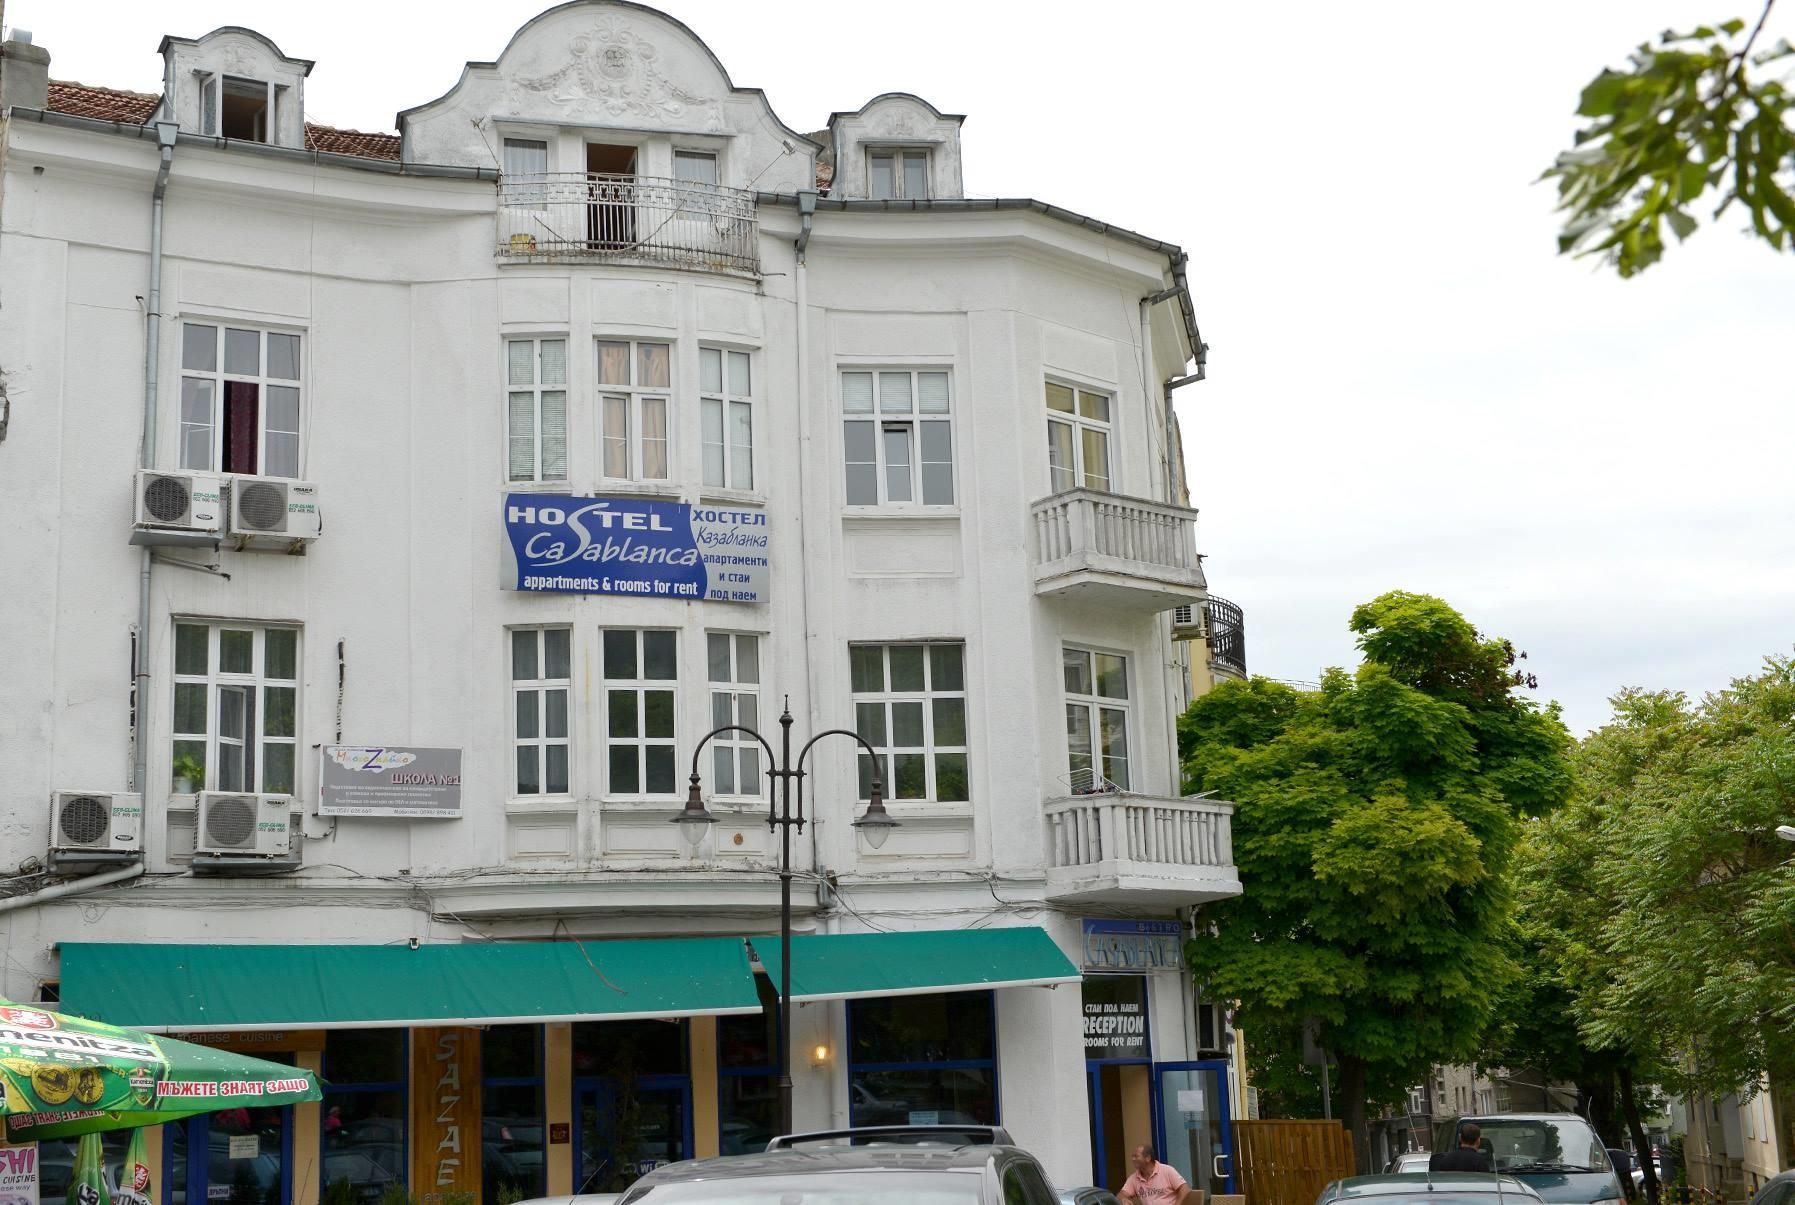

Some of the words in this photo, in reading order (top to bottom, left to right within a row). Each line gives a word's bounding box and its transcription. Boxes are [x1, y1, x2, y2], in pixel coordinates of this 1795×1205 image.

[508, 503, 673, 535] HOSTEL
[692, 509, 766, 526] ХОСТЕЛ
[697, 526, 768, 548] Казабланка
[703, 552, 768, 567] апартаменти
[719, 572, 725, 582] и
[728, 572, 750, 583] стаи
[524, 575, 599, 591] appartments
[603, 577, 611, 591] &
[614, 580, 651, 592] rooms
[654, 579, 670, 593] for
[674, 581, 698, 595] rent
[711, 590, 729, 601] под
[732, 590, 757, 601] наем
[391, 773, 437, 785] ШКОЛА
[1085, 1003, 1102, 1013] СТАИ
[1104, 1004, 1118, 1013] ПОД
[1120, 1004, 1139, 1013] НАЕМ
[1082, 1016, 1144, 1034] RECEPTION
[240, 1031, 284, 1042] cuisine
[1084, 1037, 1108, 1047] ROOMS
[1111, 1037, 1124, 1047] FOR
[1127, 1037, 1143, 1047] RENT
[158, 1081, 217, 1096] МЪЖЕТЕ
[220, 1081, 263, 1096] ЗНАЯТ
[267, 1079, 308, 1093] ЗАЩО
[3, 1174, 36, 1185] CUISINE
